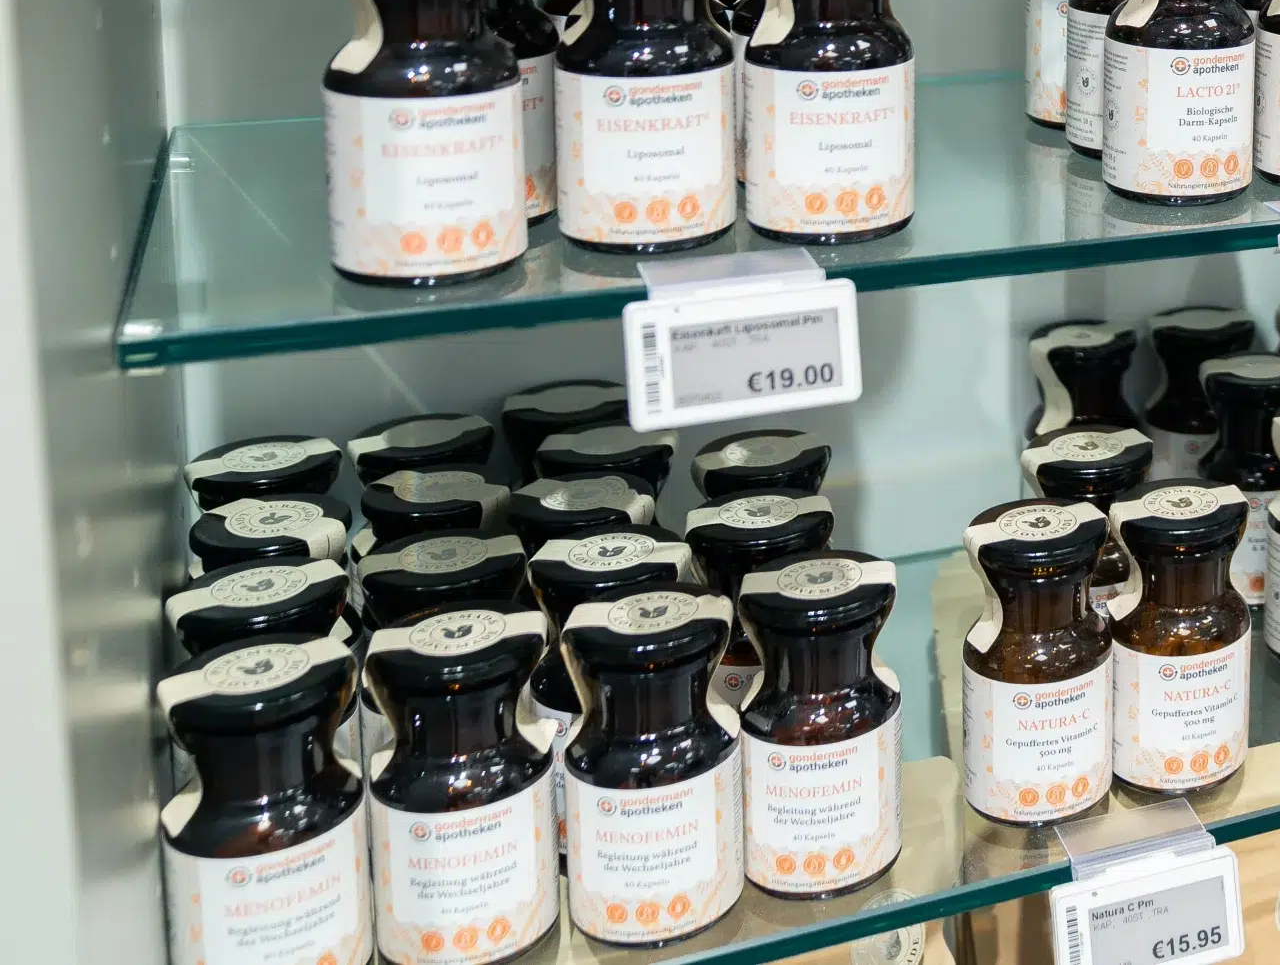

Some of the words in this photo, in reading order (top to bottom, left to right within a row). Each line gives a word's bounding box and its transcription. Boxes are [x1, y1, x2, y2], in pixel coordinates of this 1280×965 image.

[1193, 53, 1245, 67] gondermann
[1193, 63, 1239, 76] apotheken
[822, 75, 890, 92] gondermann
[1176, 85, 1223, 99] LACTO
[629, 91, 692, 107] apotheken
[822, 86, 881, 103] apotheken
[1178, 115, 1238, 127] Darm-Kapseln
[1186, 105, 1234, 118] Biologische
[818, 138, 873, 155] Liposomal
[1202, 133, 1228, 143] Kapseln
[627, 145, 685, 162] Liposomal
[747, 362, 834, 393] €19.00
[1150, 487, 1209, 506] HANDMADE
[1003, 505, 1065, 528] HANDMADE
[1153, 499, 1215, 518] LOVEMADE
[1011, 517, 1074, 538] LOVEMADE
[1179, 651, 1235, 673] gondermann
[1179, 662, 1228, 681] apotheken
[1034, 679, 1094, 702] gondermann
[1163, 678, 1232, 703] NATURA-C
[1034, 691, 1086, 711] apotheken
[1151, 707, 1202, 719] Gepuffertes
[1203, 697, 1233, 715] Vitamin
[1232, 692, 1239, 701] C
[1017, 708, 1091, 732] NATURA-C
[1183, 717, 1200, 727] 500
[1201, 714, 1216, 726] mg
[1005, 734, 1059, 749] Gepuffertes
[1060, 726, 1093, 745] Vitamin
[1092, 721, 1099, 731] C
[1190, 729, 1217, 742] Kapseln
[789, 745, 858, 764] gondermann
[1038, 748, 1057, 758] 500
[1058, 744, 1073, 757] mg
[789, 756, 848, 774] apotheken
[1046, 759, 1075, 772] Kapseln
[765, 776, 863, 800] MENOFEMIN
[620, 800, 683, 818] apotheken
[767, 802, 819, 817] Begleitung
[821, 796, 861, 814] während
[773, 814, 789, 826] der
[790, 809, 856, 828] Wechseljahre
[595, 819, 699, 844] MENOFEMIN
[407, 838, 519, 871] MENOFEMIN
[1091, 906, 1125, 922] Natura
[1127, 903, 1135, 912] C
[1137, 898, 1154, 910] Pm
[1152, 925, 1222, 960] €15.95
